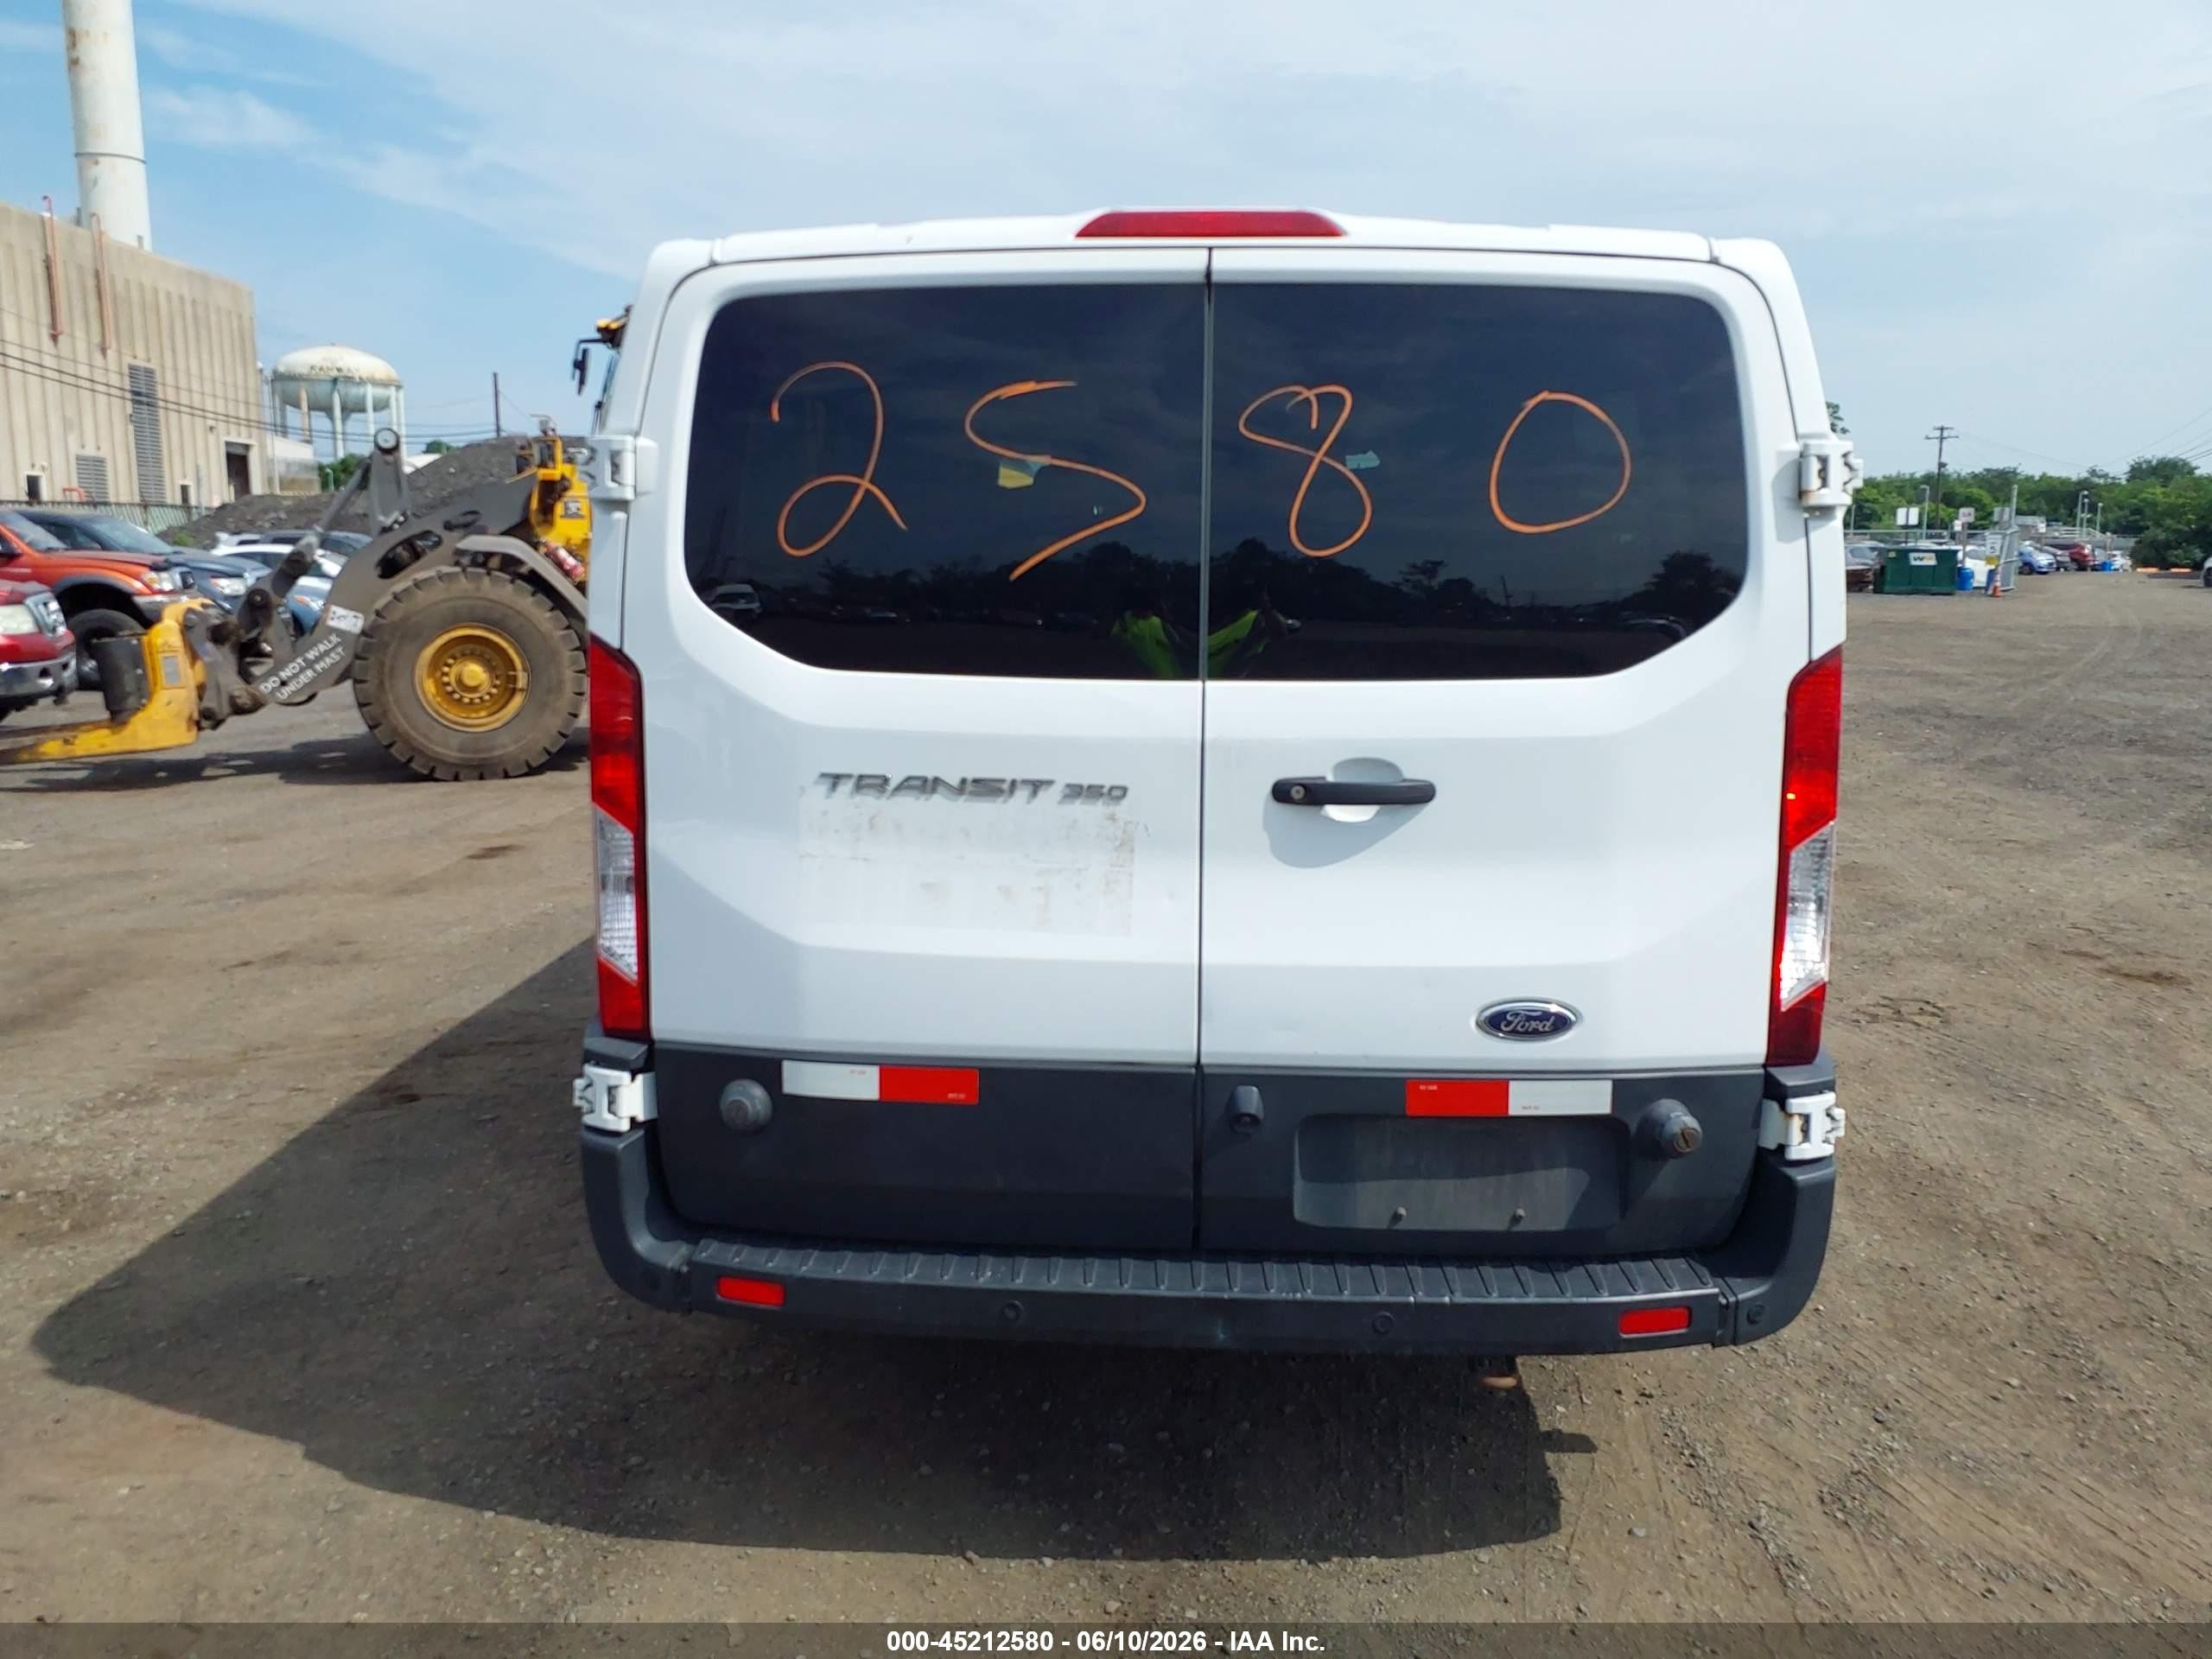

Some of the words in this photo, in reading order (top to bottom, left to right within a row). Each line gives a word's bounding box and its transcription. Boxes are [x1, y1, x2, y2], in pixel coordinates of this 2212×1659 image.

[260, 677, 281, 694] DO
[279, 656, 307, 680] NOT
[305, 633, 341, 661] WALK
[276, 669, 317, 699] UNDER
[315, 645, 346, 672] MAST
[817, 772, 1055, 801] TRANSIT
[1059, 783, 1128, 804] 350
[1500, 1008, 1556, 1033] Ford
